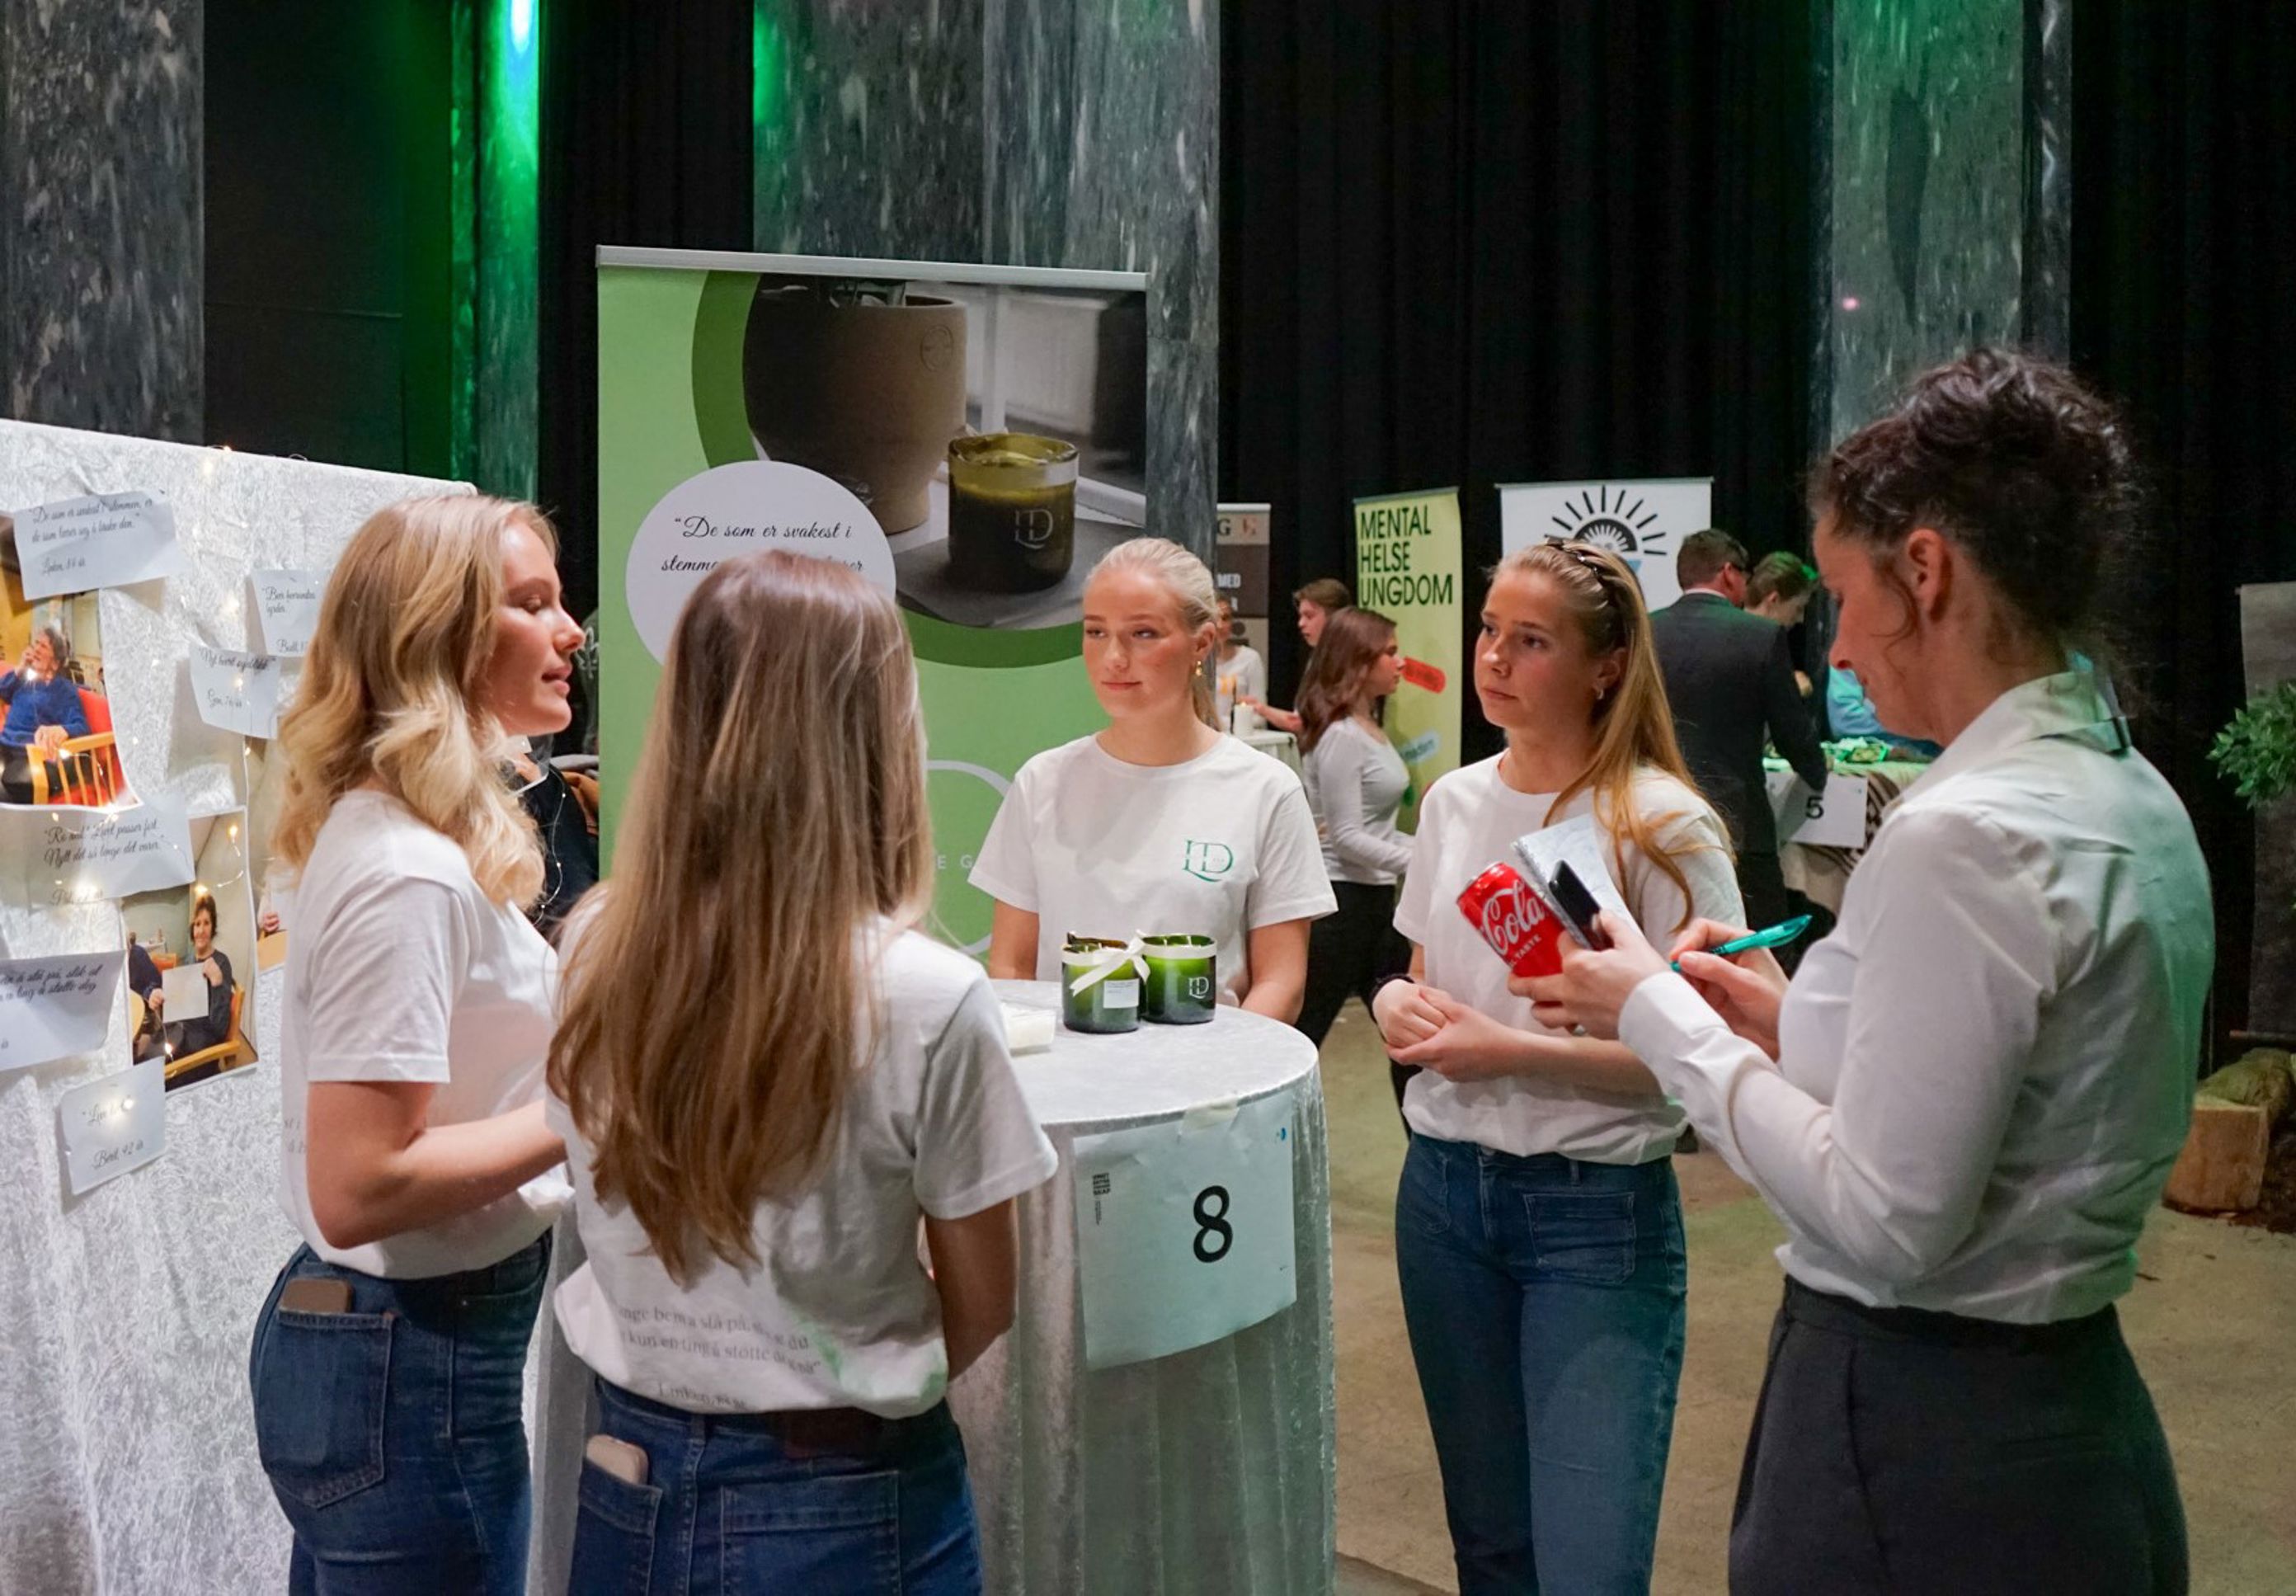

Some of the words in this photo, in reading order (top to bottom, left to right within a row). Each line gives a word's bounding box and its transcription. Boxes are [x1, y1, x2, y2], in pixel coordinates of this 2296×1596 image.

[723, 525, 755, 537] som
[763, 525, 777, 537] er
[783, 521, 840, 538] svakest
[845, 525, 852, 538] i
[1361, 502, 1432, 540] MENTAL
[1361, 541, 1410, 573] HELSE
[1361, 573, 1453, 606] UNGDOM
[1805, 796, 1824, 819] 5
[1482, 879, 1546, 956] Cola
[1514, 934, 1541, 959] TASTE
[1193, 1185, 1233, 1263] 8
